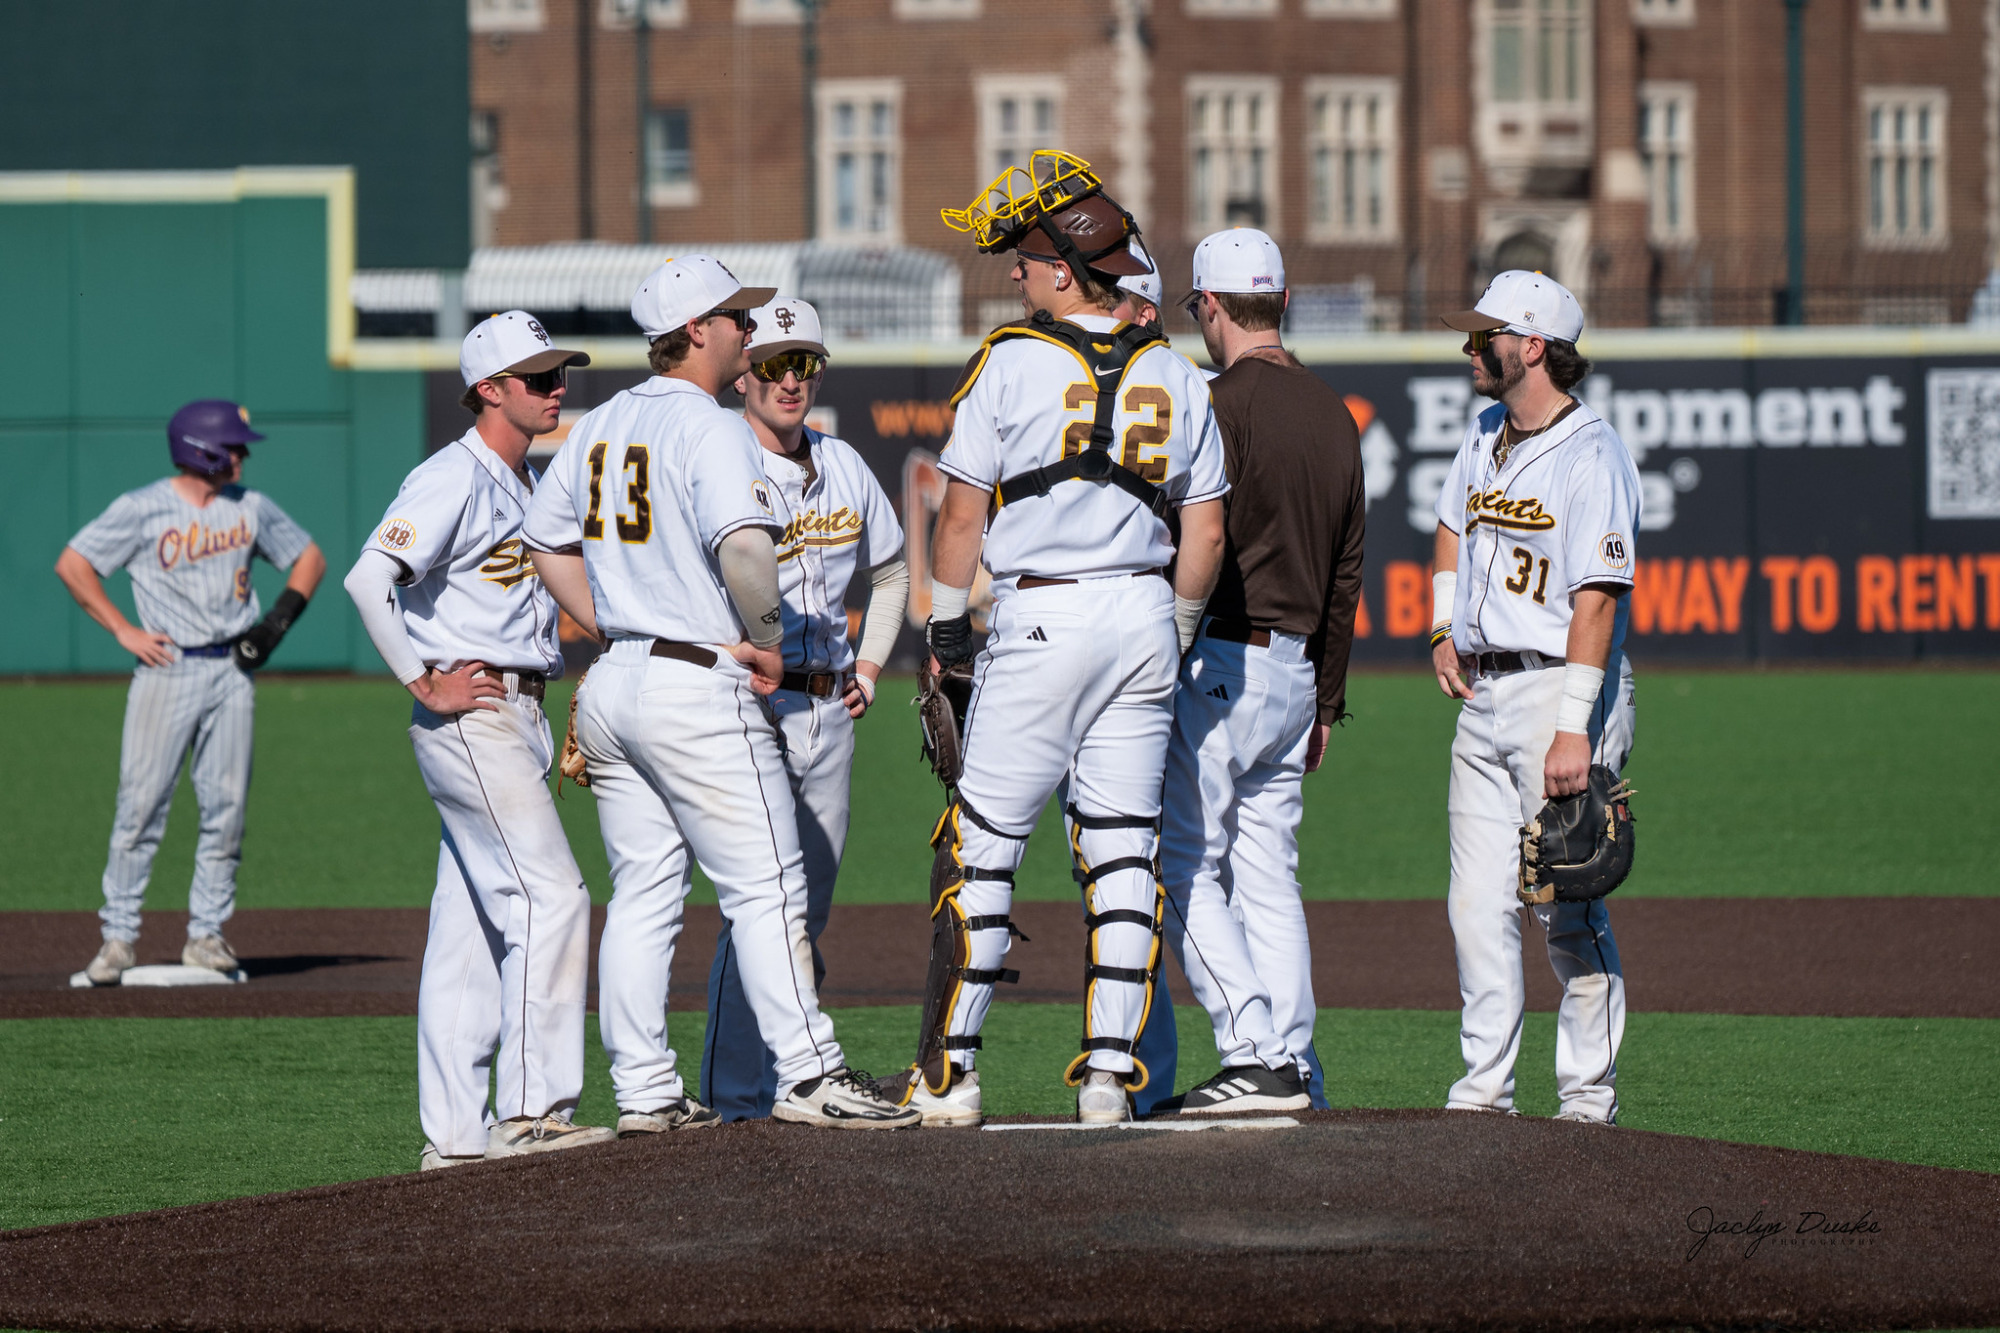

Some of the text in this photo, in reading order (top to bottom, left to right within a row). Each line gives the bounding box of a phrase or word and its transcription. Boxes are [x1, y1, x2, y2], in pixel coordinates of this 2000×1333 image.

[1060, 381, 1174, 484] 22
[1406, 373, 1906, 463] Eipment
[583, 441, 653, 544] 13
[157, 516, 253, 572] Olivet
[385, 526, 411, 546] 48
[1605, 540, 1626, 560] 49
[1505, 546, 1550, 606] 31
[1632, 554, 2000, 634] WAY TO RENT
